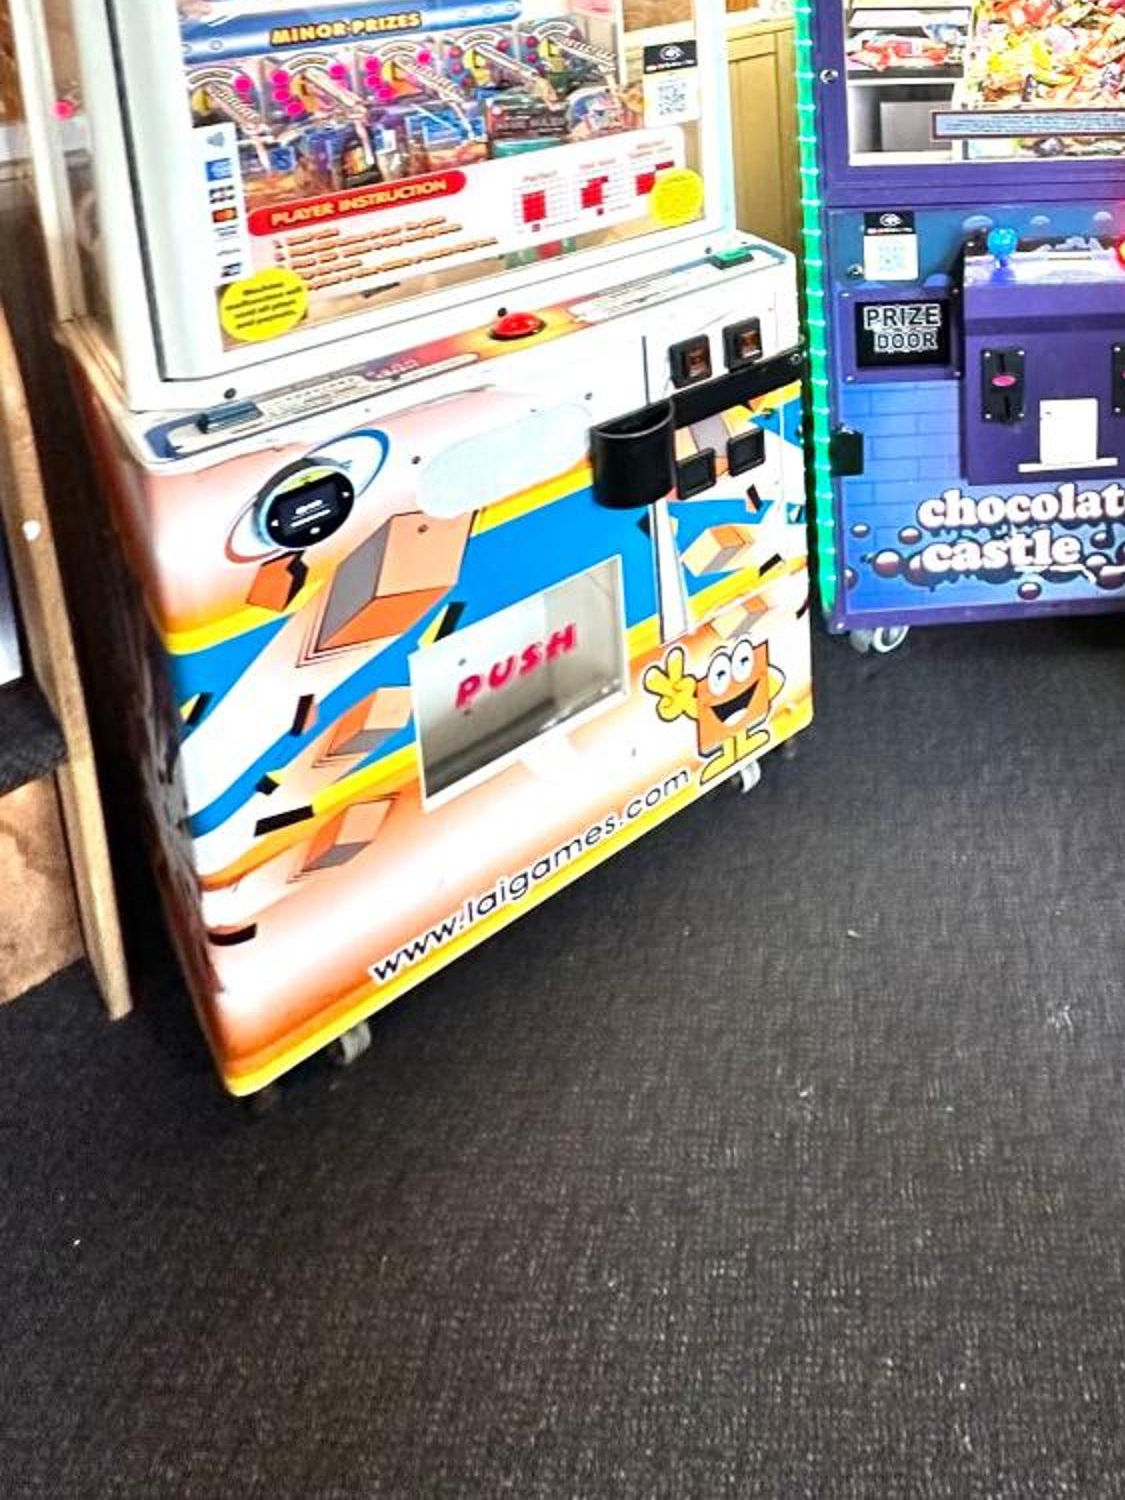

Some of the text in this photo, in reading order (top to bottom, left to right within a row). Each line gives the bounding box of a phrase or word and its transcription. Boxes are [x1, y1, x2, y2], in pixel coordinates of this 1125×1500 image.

[270, 11, 422, 46] MINOR PRIZES
[271, 178, 448, 227] PLAYER INSTRUCTION
[865, 303, 941, 329] PRIZE
[875, 330, 939, 351] DOOR
[922, 530, 1081, 572] castle
[454, 622, 578, 710] PUSH
[372, 767, 691, 982] www.laigames.com
